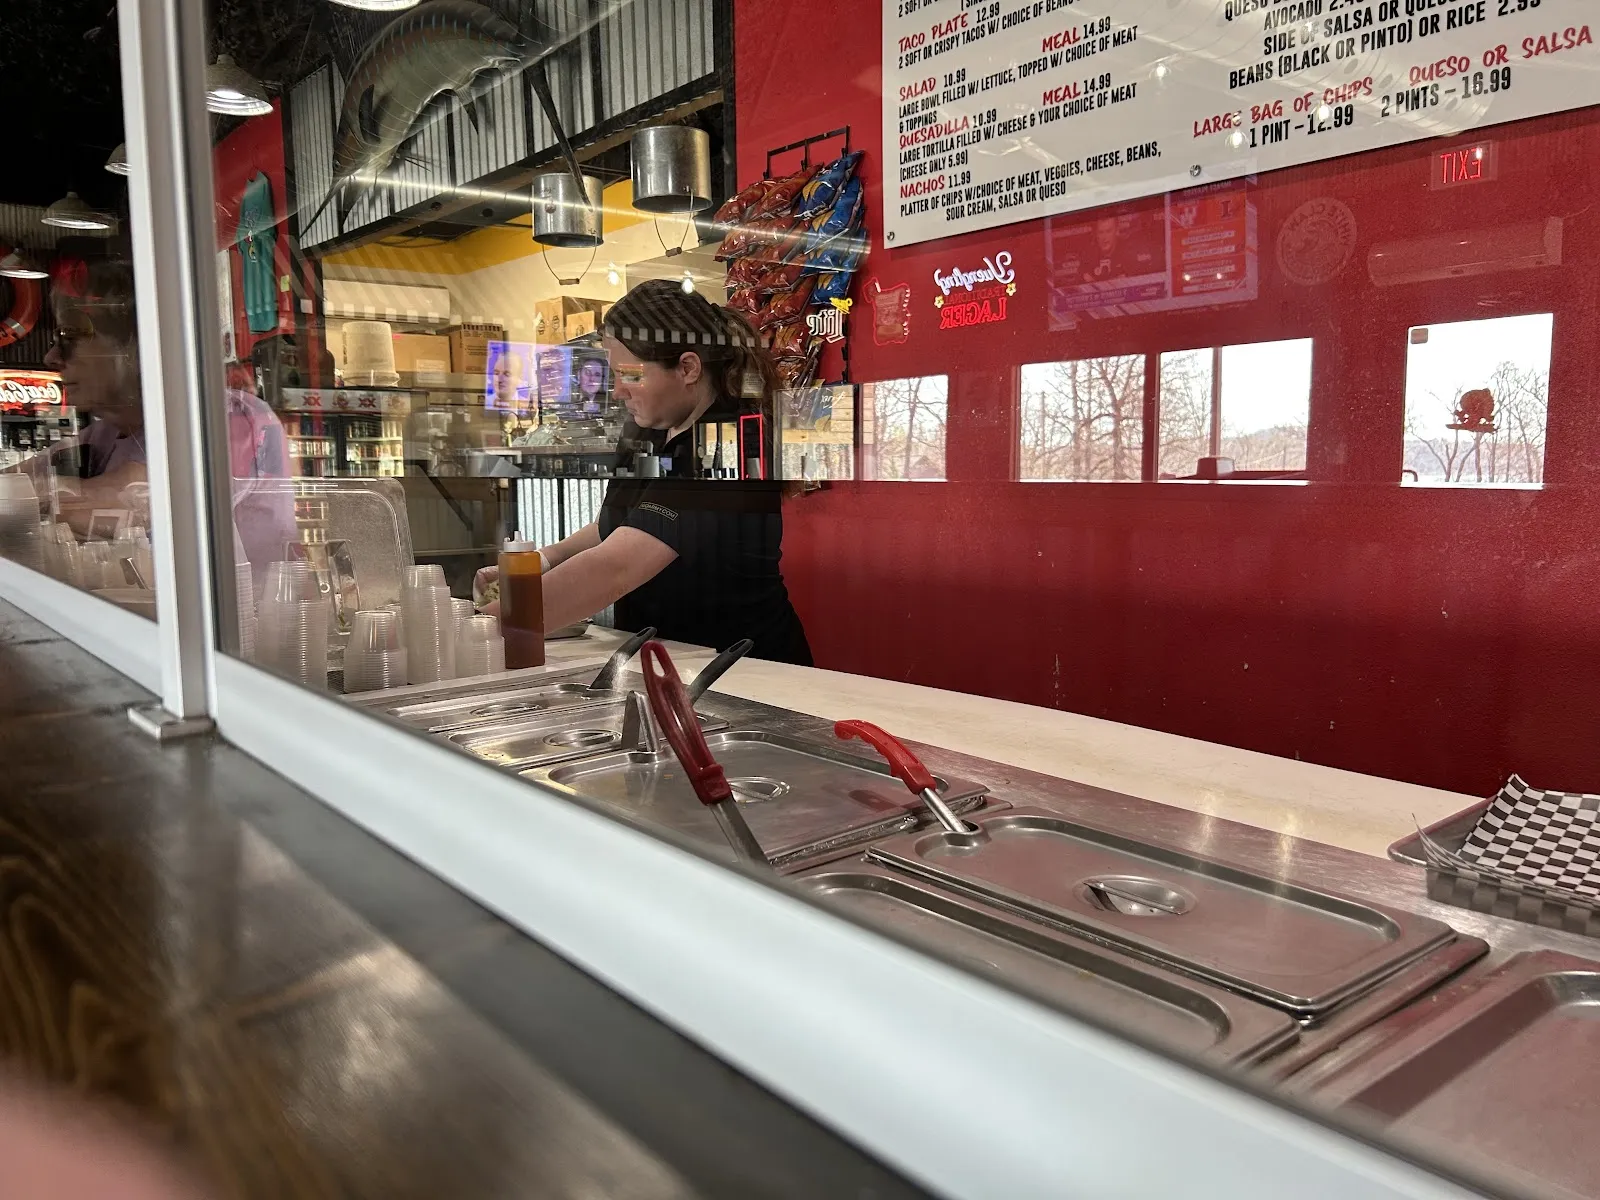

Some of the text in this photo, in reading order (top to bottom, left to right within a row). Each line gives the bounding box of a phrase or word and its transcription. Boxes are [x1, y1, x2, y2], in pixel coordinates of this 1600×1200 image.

[898, 32, 925, 53] TACO
[931, 13, 968, 40] PLATE
[976, 2, 1000, 23] 12.99
[899, 4, 903, 18] 2
[1264, 0, 1322, 30] AVOCADO
[1264, 28, 1296, 55] SIDE
[1324, 6, 1372, 38] SALSA
[1378, 1, 1399, 22] OR
[899, 57, 903, 69] 2
[905, 49, 921, 67] SOFT
[924, 45, 932, 60] OR
[934, 34, 960, 56] CRISPY
[962, 24, 985, 45] TACOS
[988, 18, 999, 35] W/
[1002, 6, 1030, 30] CHOICE
[1033, 1, 1044, 18] OF
[1042, 16, 1110, 52] MEAL 14.99
[1230, 60, 1273, 89] BEANS
[1278, 44, 1330, 78] (BLACK
[1336, 37, 1355, 60] OR
[1361, 19, 1412, 52] PINTO)
[1419, 14, 1440, 37] OR
[1446, 1, 1486, 30] RICE
[899, 25, 1138, 118] LARGE BOWL FILLED W/ LETTUCE, TOPPED W/ CHOICE OF MEAT
[1409, 25, 1593, 87] QUESO OR SALSA
[900, 68, 966, 102] SALAD 10.99
[1042, 73, 1110, 106] MEAL 14.99
[1382, 95, 1390, 118] 2
[1396, 83, 1439, 114] PINTS
[1462, 66, 1511, 99] 16.99
[900, 110, 937, 134] & TOPPINGS
[900, 82, 1137, 164] LARGE TORTILLA FILLED W/ CHEESE & YOUR CHOICE OF MEAT
[1194, 76, 1373, 138] LARGE BAG OF CHIPS
[900, 108, 996, 150] QUESADILLA 10.99
[1250, 128, 1257, 148] 1
[1262, 119, 1290, 145] PINT
[900, 150, 968, 182] (CHEESE ONLY 5.99)
[900, 141, 1161, 217] PLATTER OF CHIPS W/CHOICE OF MEAT, VEGGIES, CHEESE, BEANS,
[900, 170, 971, 198] NACHOS 11.99
[946, 181, 1066, 221] SOUR CREAM, SALSA OR QUESO
